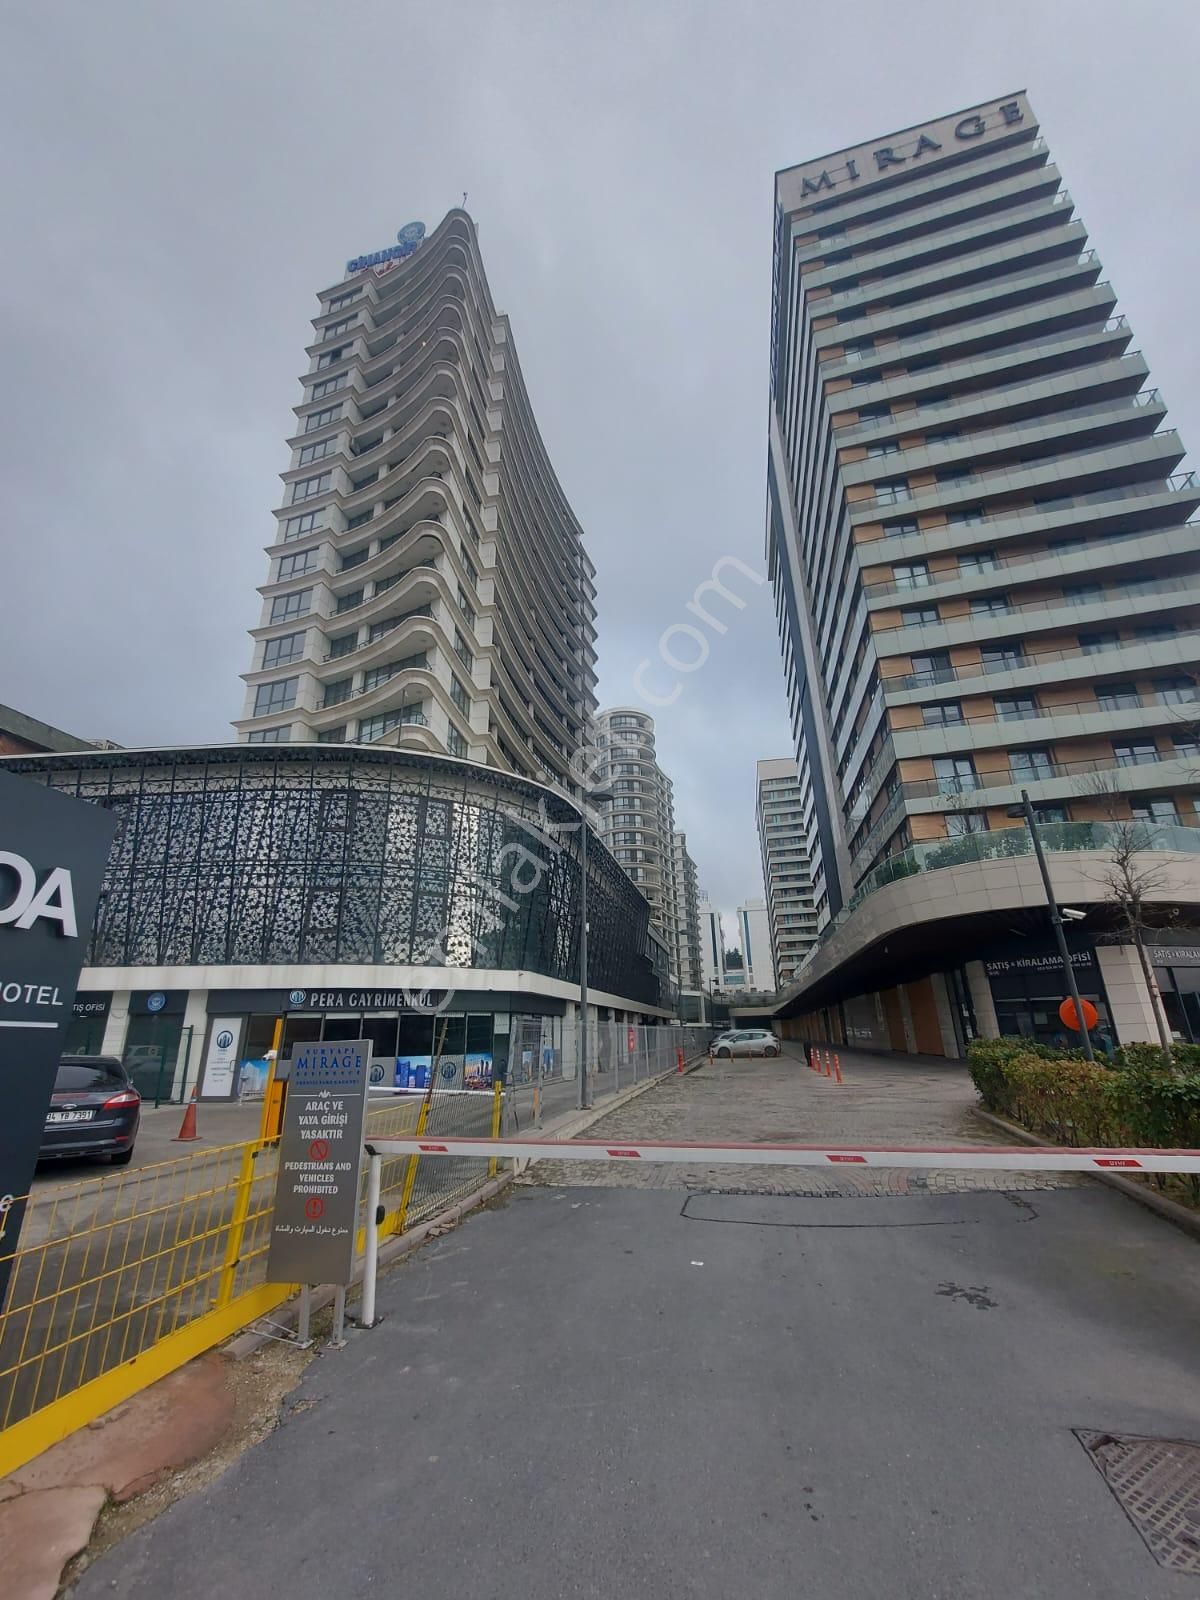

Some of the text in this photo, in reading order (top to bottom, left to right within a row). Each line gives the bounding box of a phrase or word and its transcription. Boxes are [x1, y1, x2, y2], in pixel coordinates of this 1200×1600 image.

[800, 101, 1024, 197] MIRAGE
[986, 961, 1010, 970] SATIŞ
[0, 982, 64, 1006] OTEL
[310, 991, 433, 1007] PERA GAYRİMENKUL
[297, 1055, 361, 1070] MIRAGE
[305, 1101, 344, 1113] ARAÇ VE
[298, 1112, 348, 1127] YAYA GİRİŞİ
[301, 1129, 343, 1139] YASAKTIR
[285, 1161, 352, 1171] PEDESTRIANS AND
[293, 1184, 338, 1194] PROHIBITED
